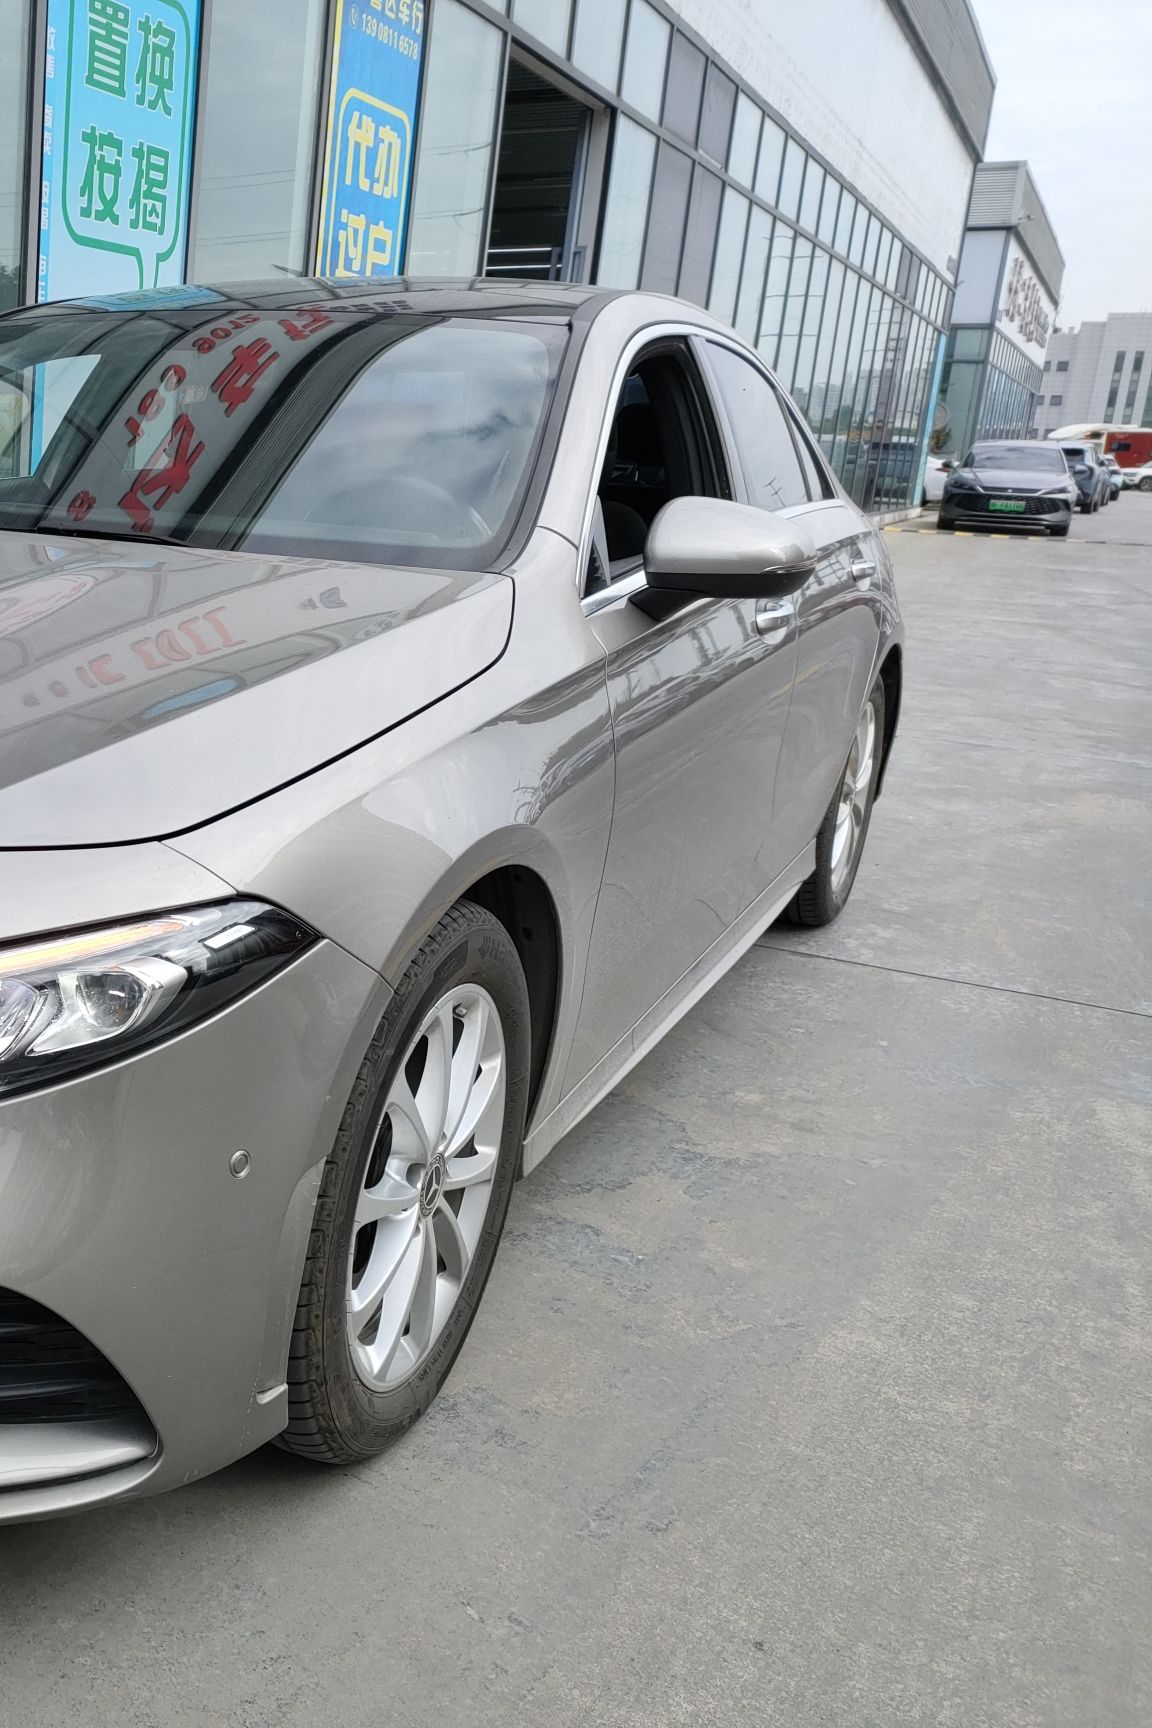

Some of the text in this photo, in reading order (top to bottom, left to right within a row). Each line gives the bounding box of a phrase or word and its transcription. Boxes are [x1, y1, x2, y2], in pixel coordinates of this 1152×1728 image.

[85, 0, 177, 118] 置换
[361, 13, 419, 60] 139 0811 6578
[79, 124, 171, 237] 按揭
[345, 111, 401, 199] 代办
[335, 208, 393, 277] 过户
